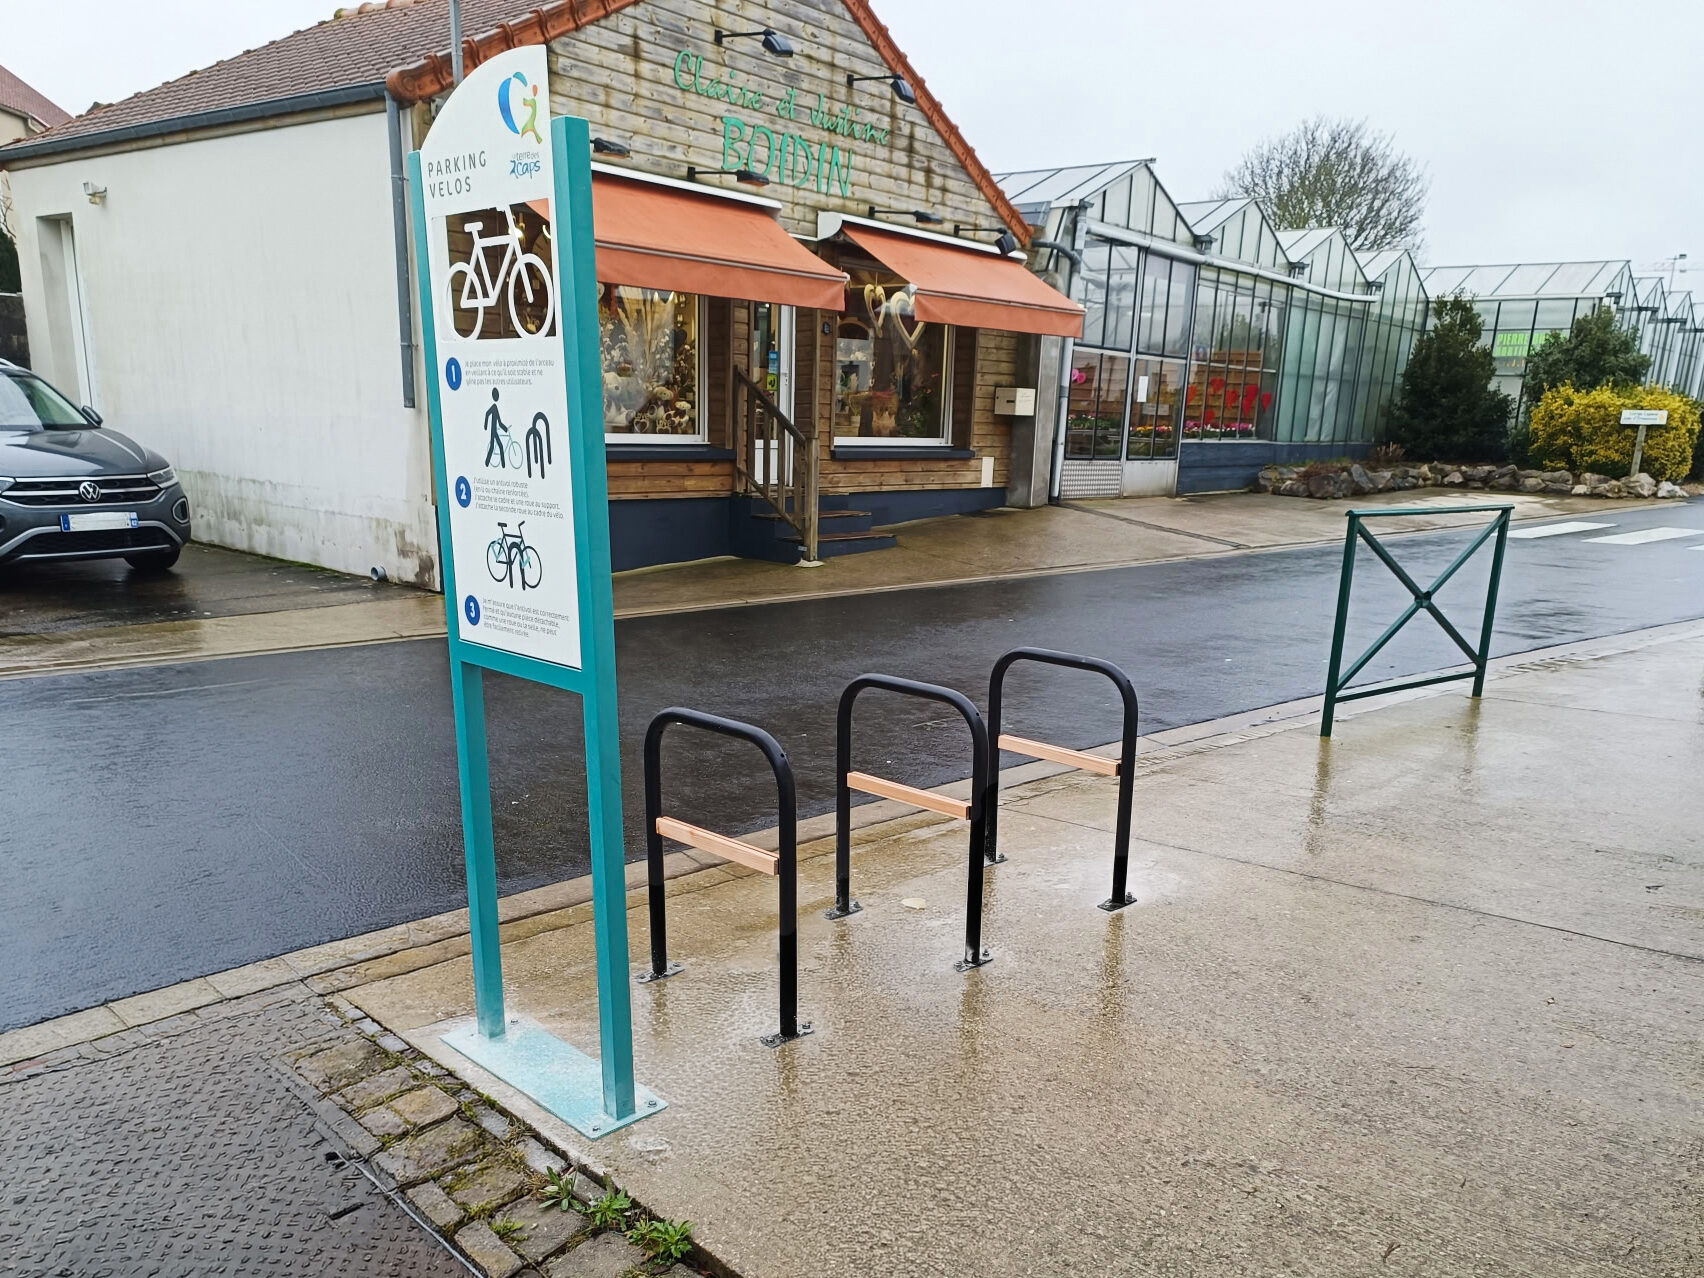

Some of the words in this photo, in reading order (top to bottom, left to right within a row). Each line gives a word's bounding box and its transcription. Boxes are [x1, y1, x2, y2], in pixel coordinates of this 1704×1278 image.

[674, 51, 763, 110] Claire
[777, 86, 796, 119] et
[811, 92, 890, 145] Justine
[428, 150, 486, 178] PARKING
[721, 117, 853, 198] BOIDIN
[429, 176, 471, 199] VELOS
[460, 483, 467, 500] 2
[469, 601, 475, 618] 3
